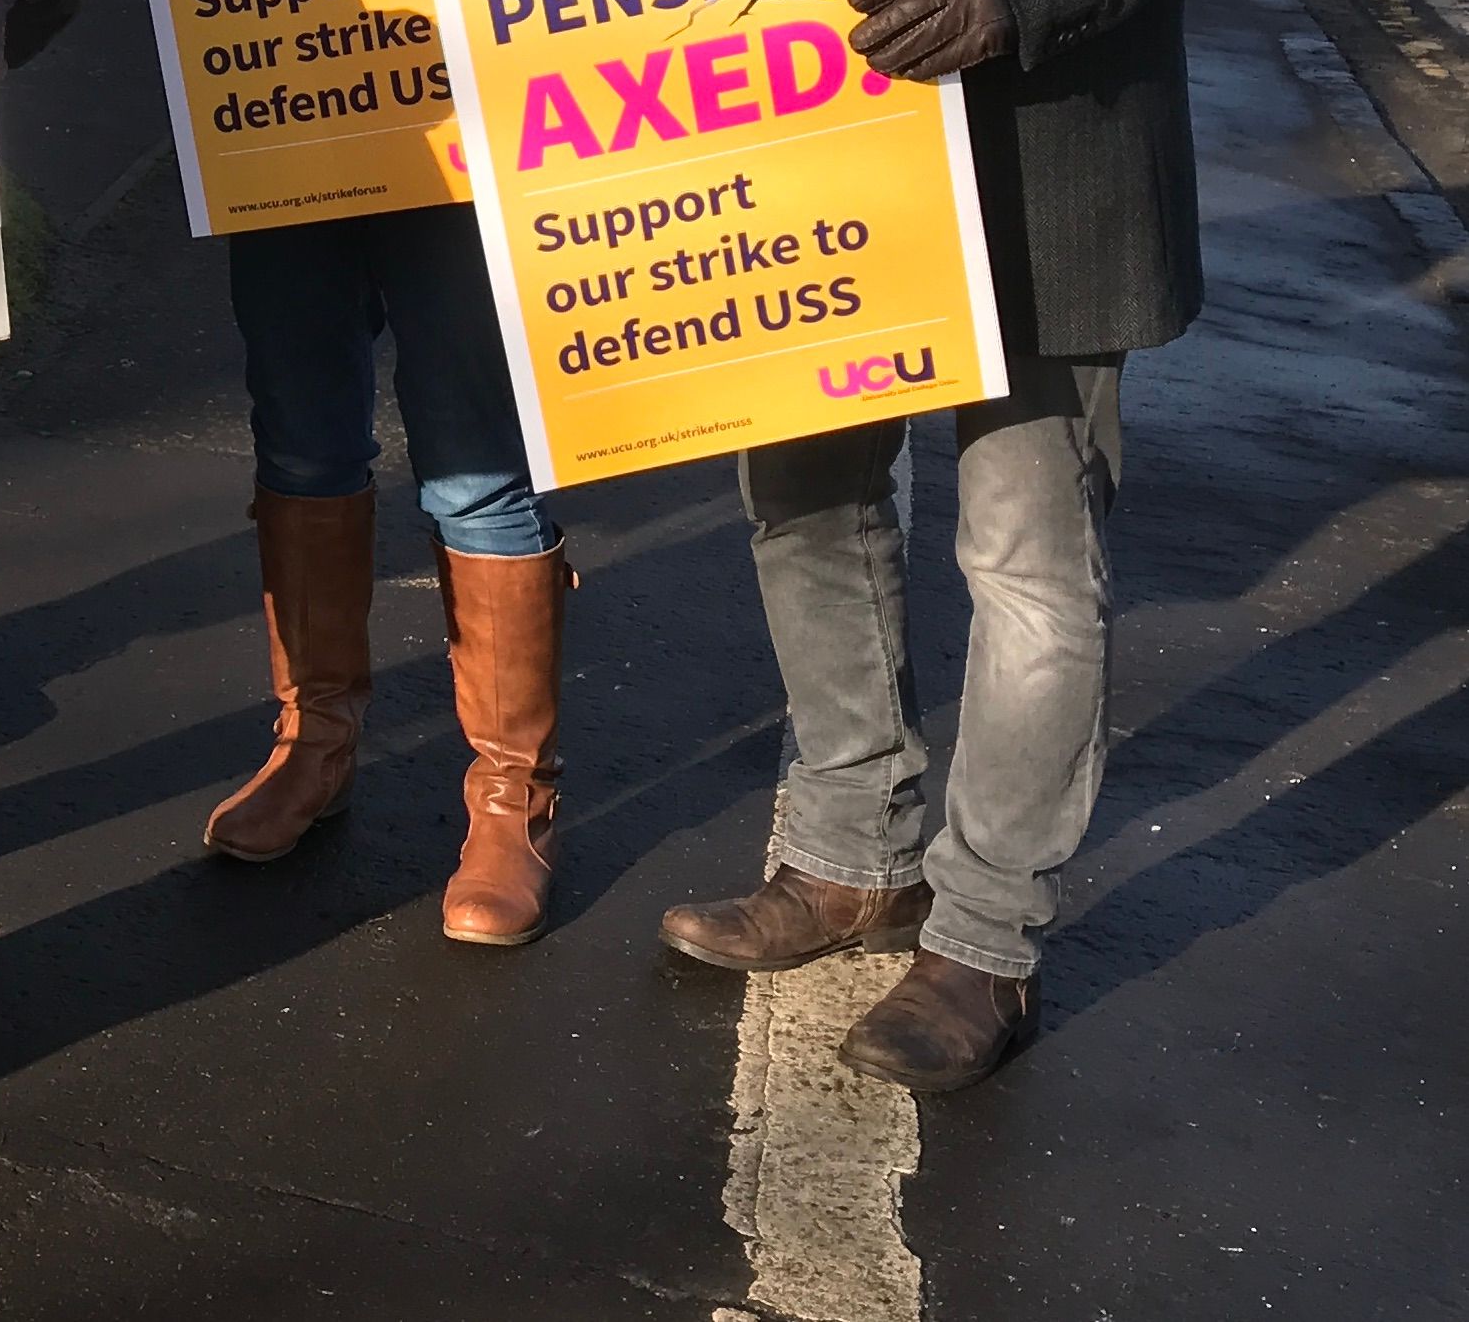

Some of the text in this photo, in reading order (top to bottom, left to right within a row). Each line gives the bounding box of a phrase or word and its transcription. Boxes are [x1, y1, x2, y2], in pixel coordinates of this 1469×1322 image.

[203, 10, 431, 76] our strike
[214, 72, 378, 133] defend
[517, 19, 892, 172] AXED.
[228, 184, 388, 215] www.ucu.org.uk/strikeforuss
[533, 173, 756, 252] Support
[546, 219, 869, 313] our strike to
[559, 276, 861, 375] defend USS
[576, 416, 753, 463] www.ucu.org.uk/strikeforuss
